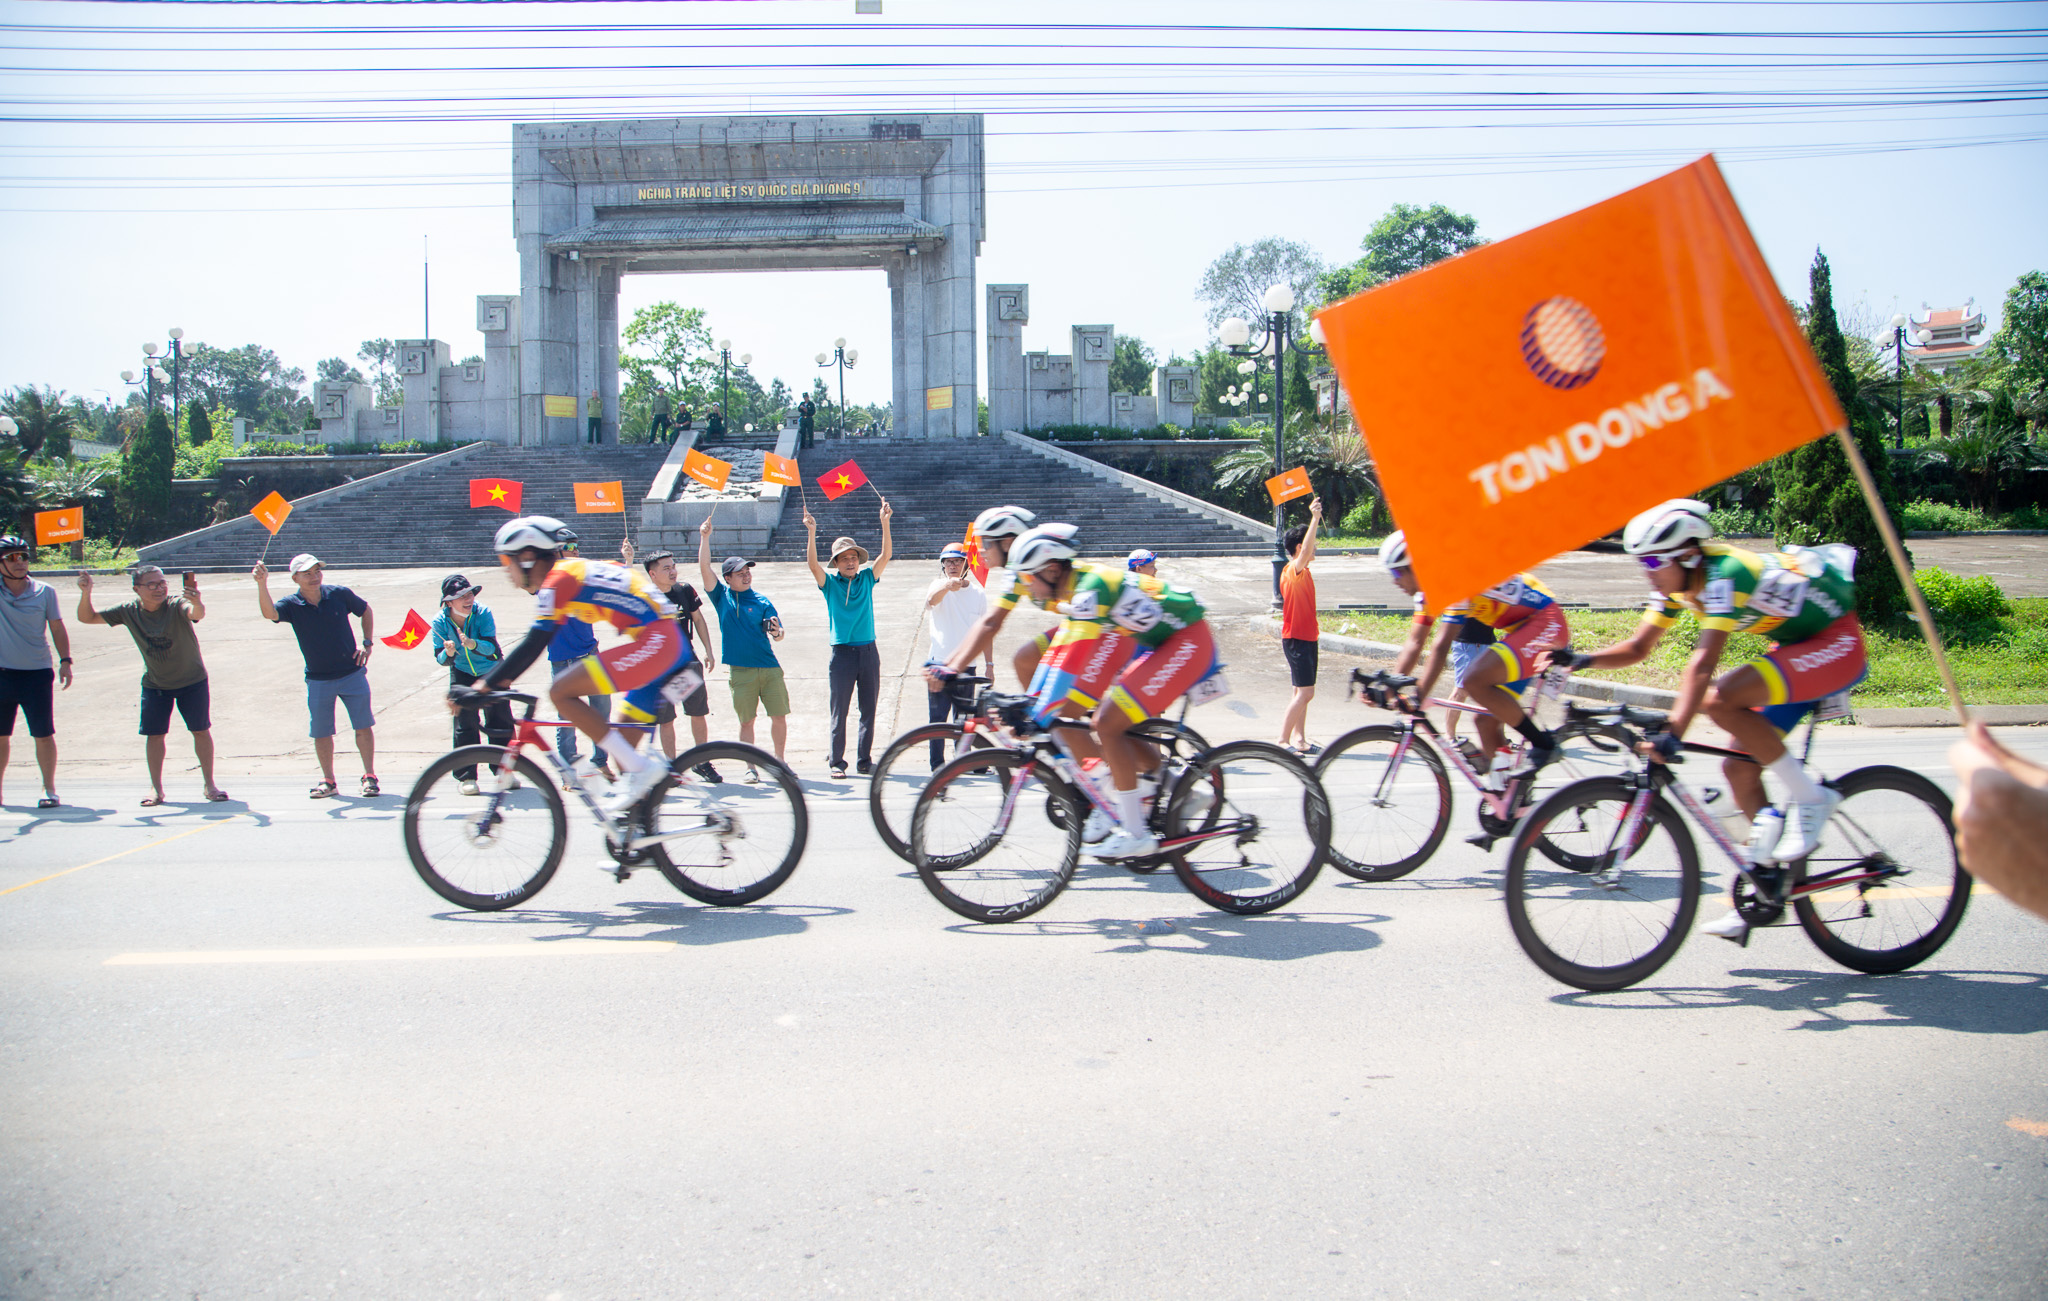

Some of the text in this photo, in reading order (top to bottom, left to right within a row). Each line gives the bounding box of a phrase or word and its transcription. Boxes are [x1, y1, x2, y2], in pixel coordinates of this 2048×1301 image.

[675, 186, 712, 199] TRANG
[714, 183, 738, 200] LIỆT
[790, 183, 810, 196] GIA
[853, 182, 861, 195] 9
[1469, 367, 1735, 504] TON DONG A
